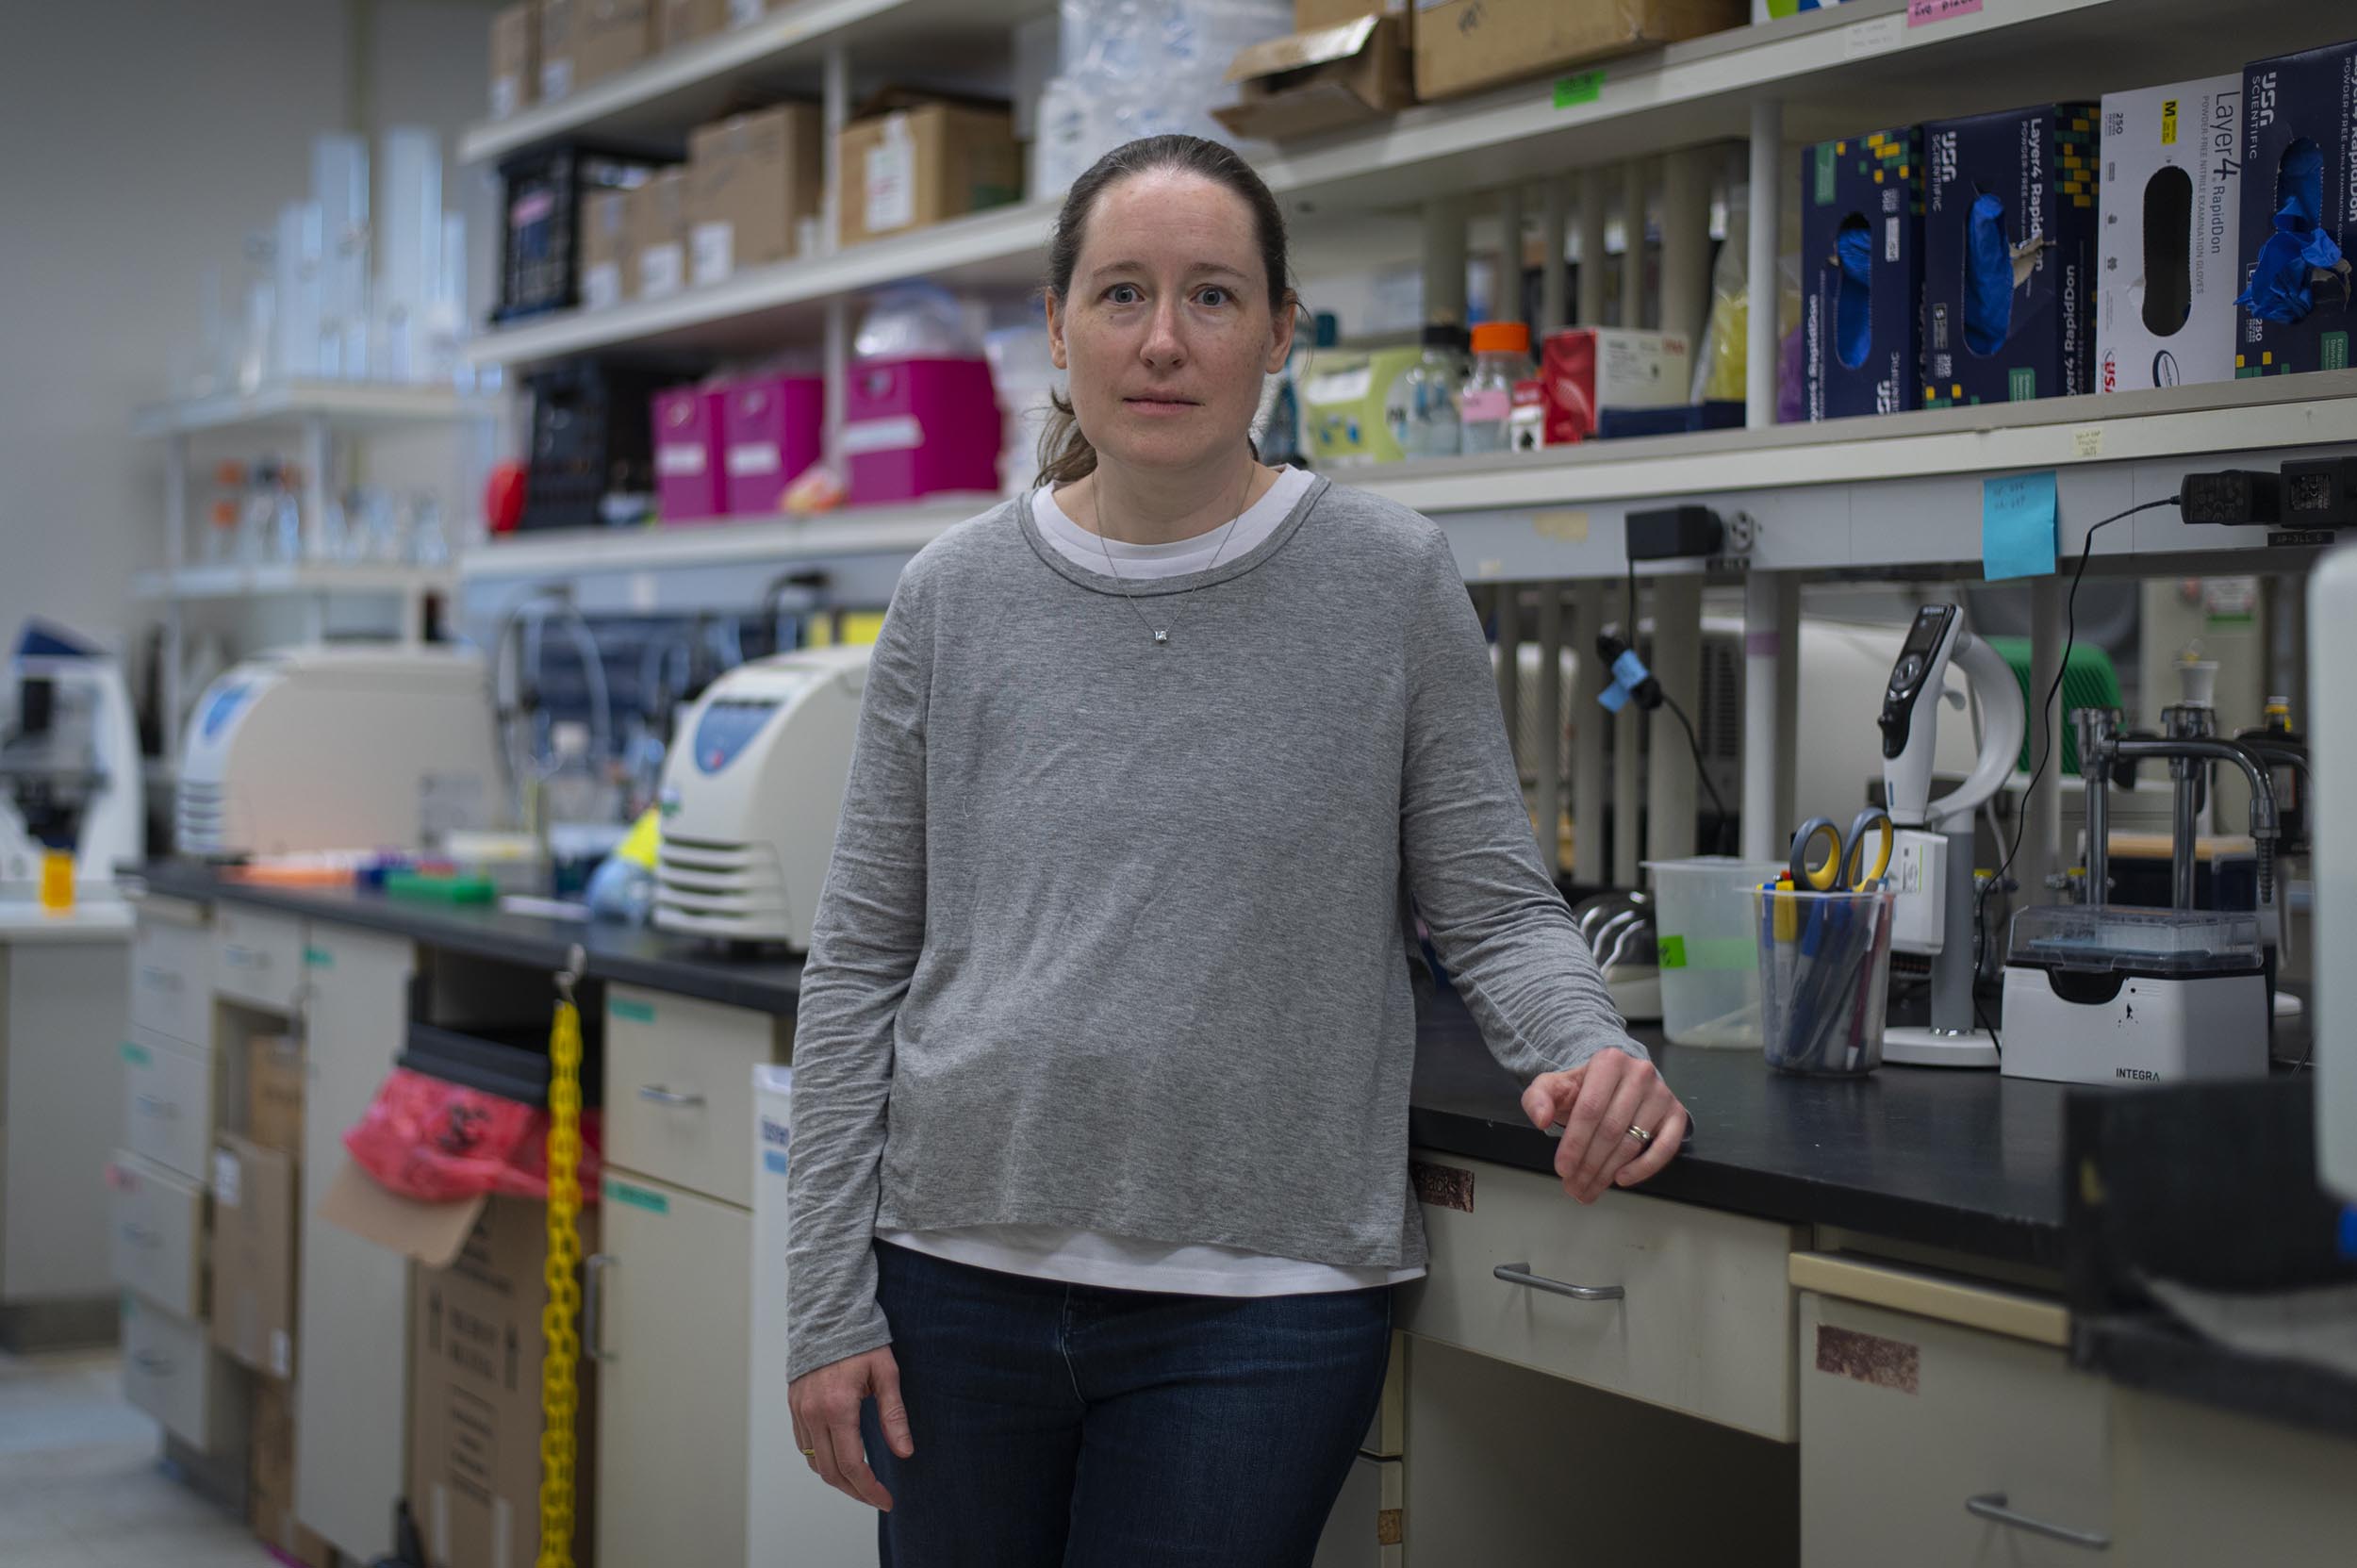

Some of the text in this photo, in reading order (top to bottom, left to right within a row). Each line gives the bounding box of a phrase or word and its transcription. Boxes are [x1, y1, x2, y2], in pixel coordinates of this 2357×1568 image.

[2116, 112, 2124, 135] 250
[2165, 101, 2176, 117] M
[2249, 75, 2260, 158] SCIENTIFIC
[2341, 58, 2350, 142] POWDER-FREE
[1931, 134, 1942, 212] SCIENTIFIC
[2029, 118, 2044, 272] Layer4 Rapidon
[2195, 95, 2210, 295] POWDER-FREE NITRILE EXAMINATION GLOVES
[2210, 91, 2241, 254] Layer4 RapidDon
[2064, 265, 2077, 395] yer4 RapidDon
[2116, 1067, 2160, 1083] INTEGRA
